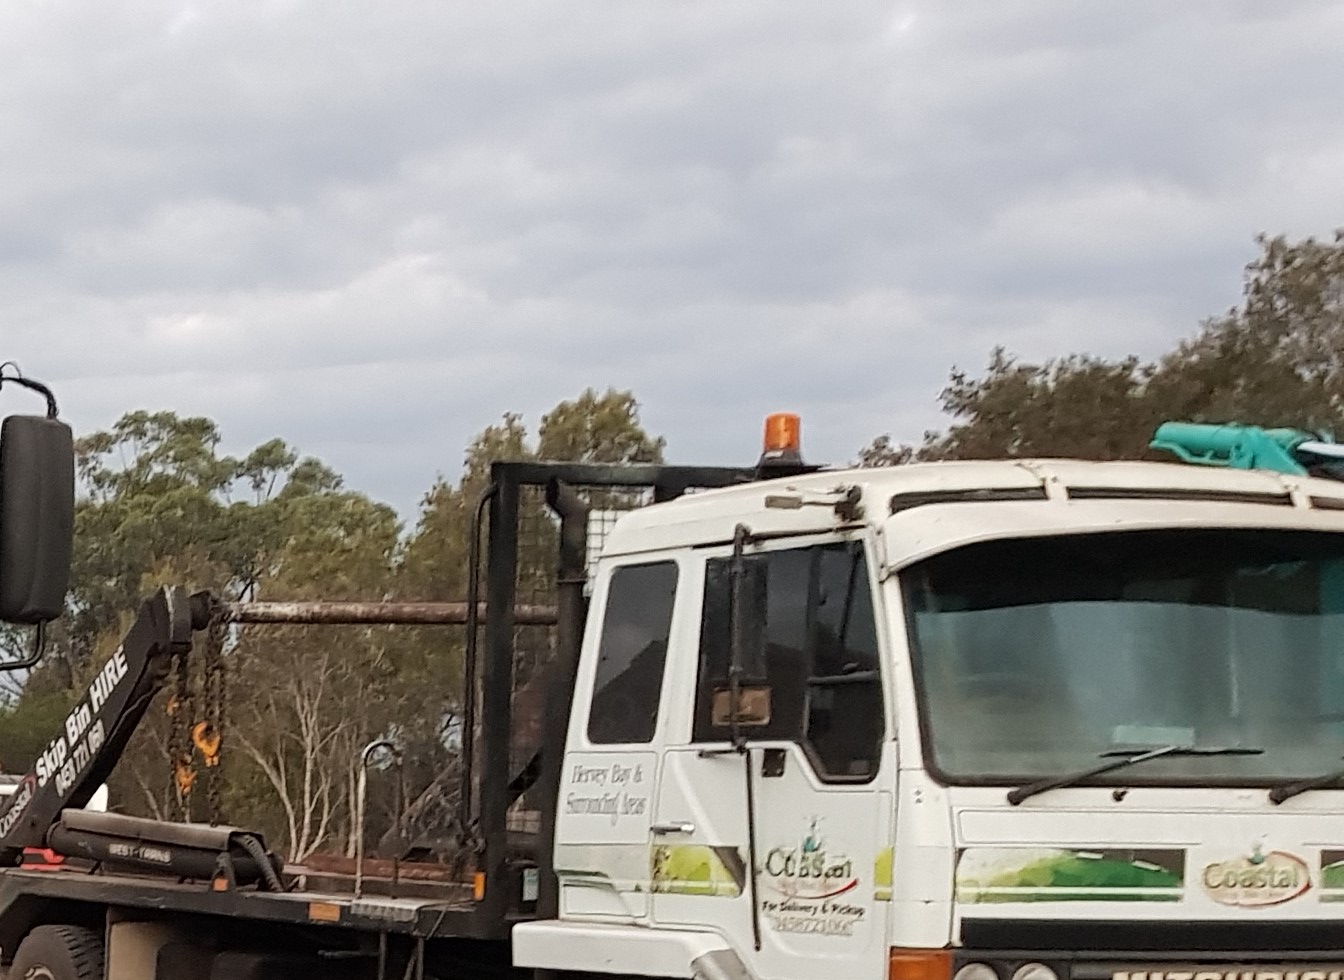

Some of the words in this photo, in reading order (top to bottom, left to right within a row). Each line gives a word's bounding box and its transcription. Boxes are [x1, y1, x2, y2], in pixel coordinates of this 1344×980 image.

[36, 736, 67, 788] Skip
[65, 702, 92, 747] Bin
[89, 644, 129, 714] HIRE
[1203, 862, 1299, 889] Coastal
